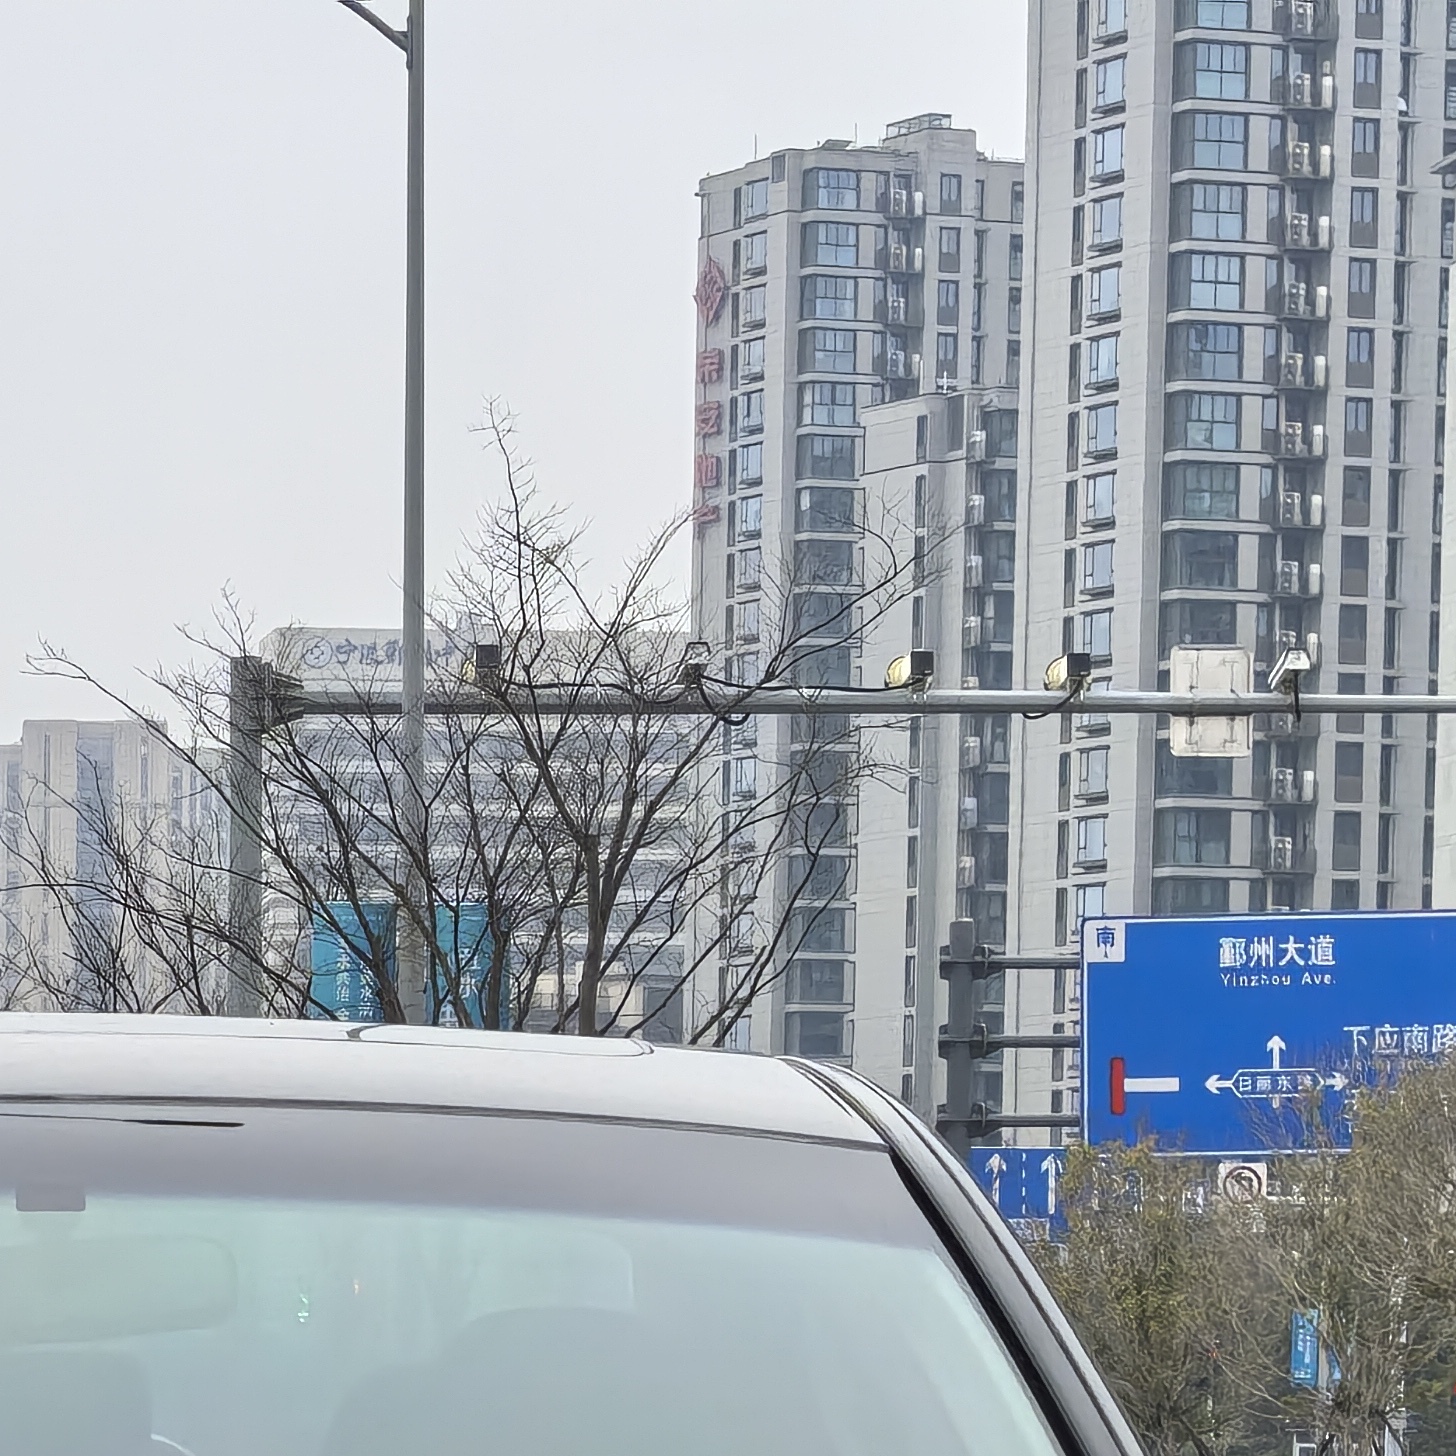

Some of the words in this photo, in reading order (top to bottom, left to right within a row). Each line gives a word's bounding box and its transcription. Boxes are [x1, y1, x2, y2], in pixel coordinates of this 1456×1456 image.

[1095, 925, 1116, 948] 南
[1219, 934, 1336, 968] 鄞州大道
[1220, 972, 1291, 987] Yinzhou
[1301, 971, 1336, 986] Ave.
